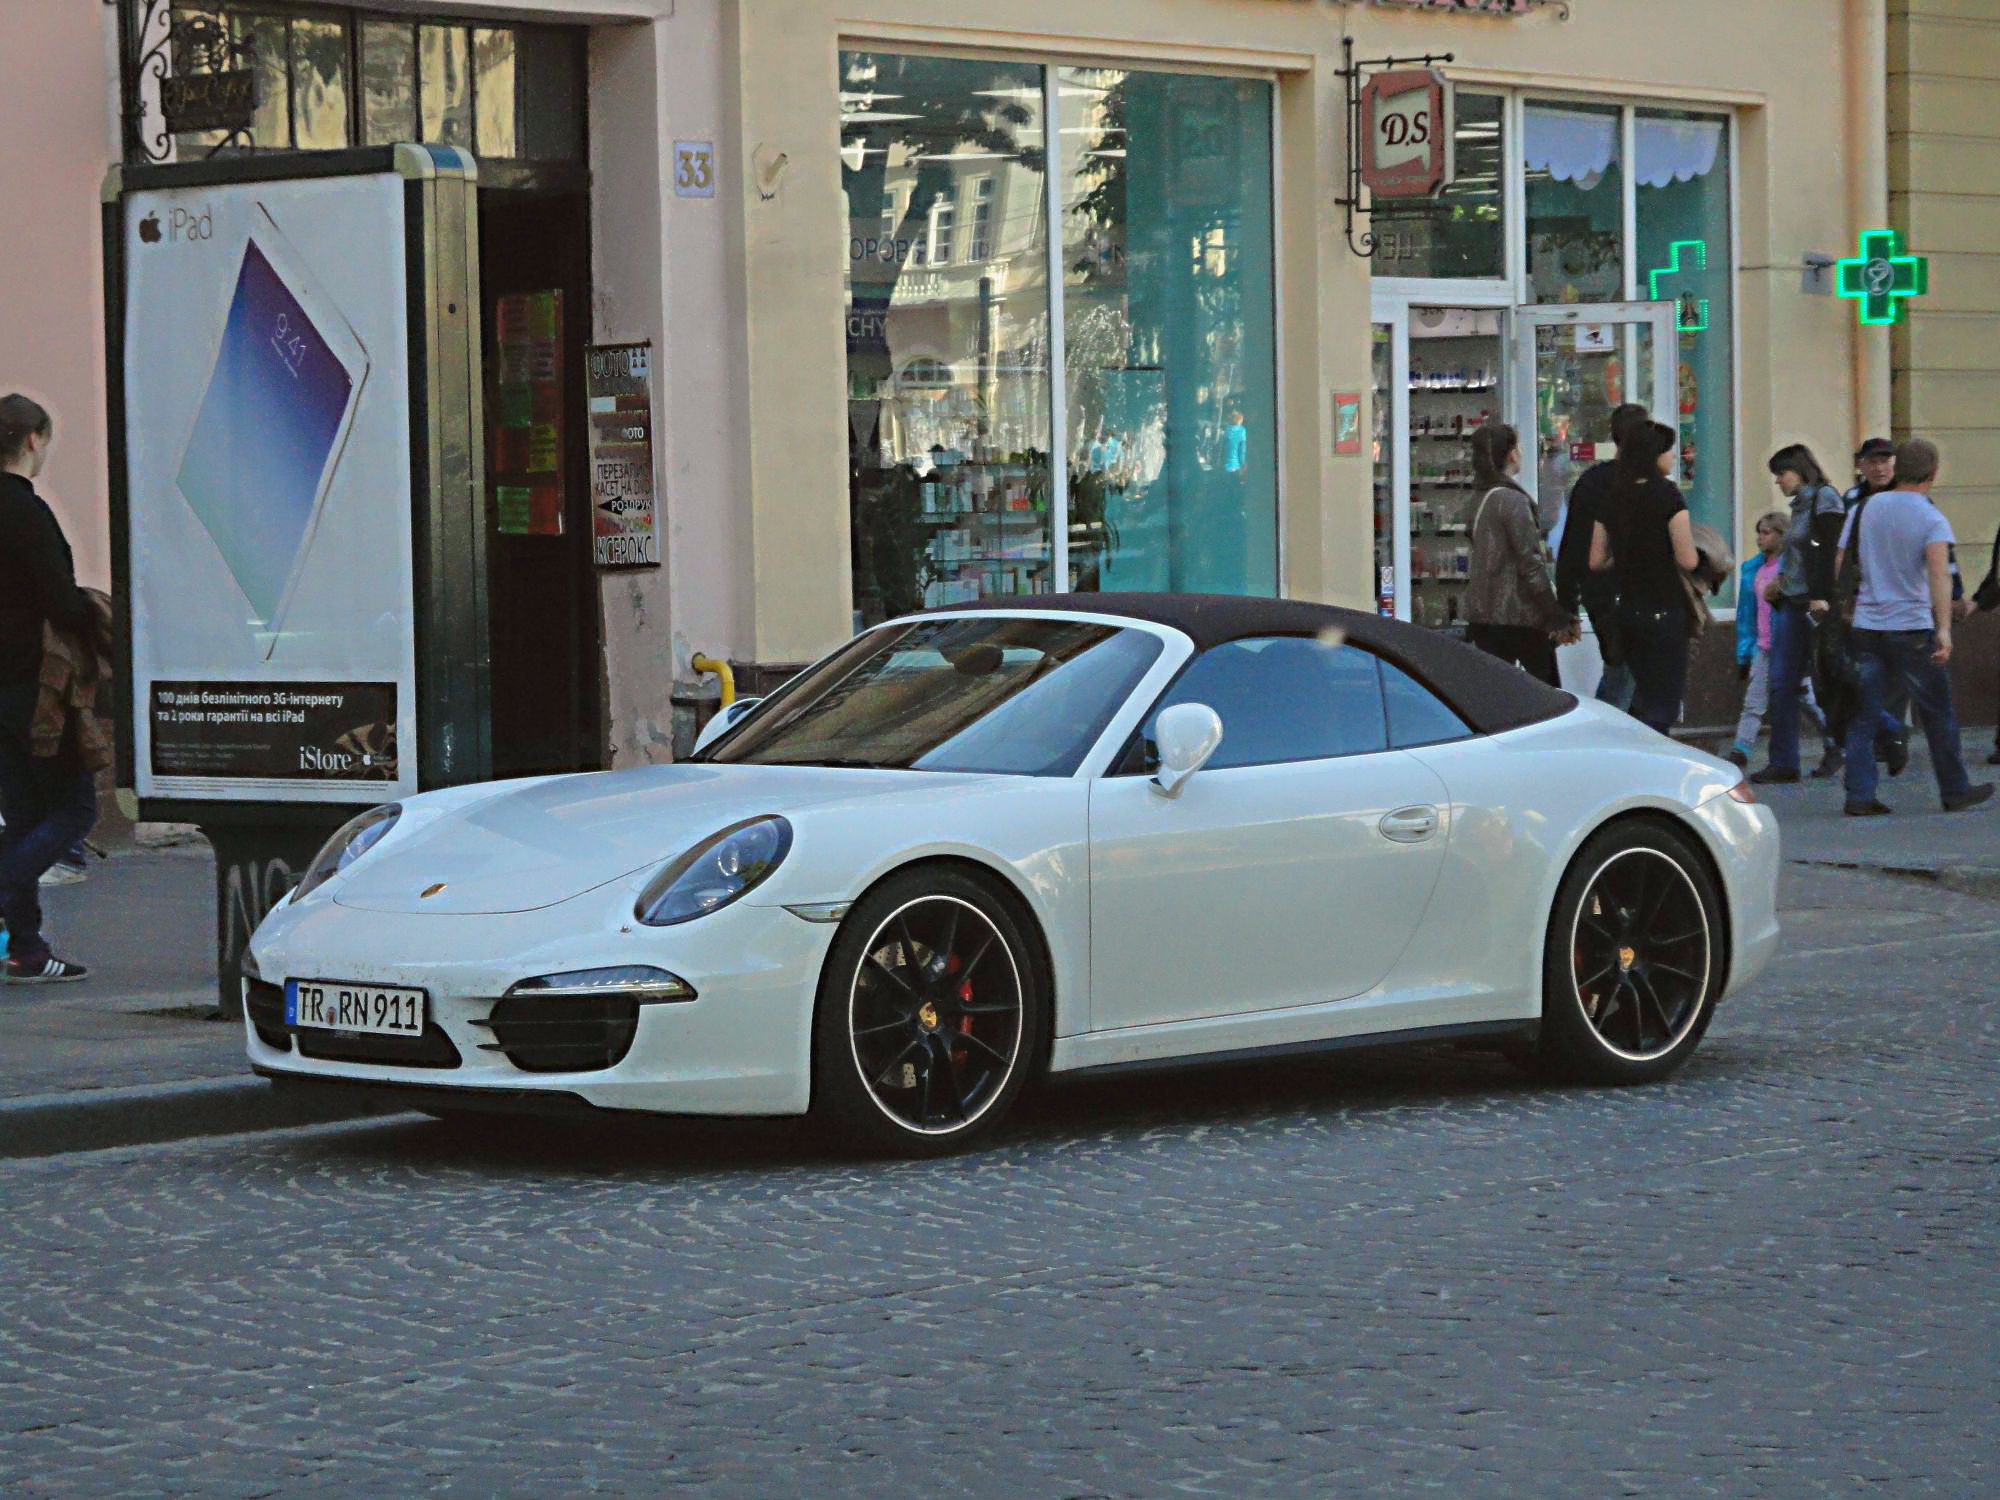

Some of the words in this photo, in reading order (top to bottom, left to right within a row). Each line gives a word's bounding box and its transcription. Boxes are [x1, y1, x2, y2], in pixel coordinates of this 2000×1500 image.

[1381, 111, 1431, 146] D.S.
[679, 151, 712, 188] 33
[169, 205, 214, 241] iPad
[590, 350, 630, 380] ФОТО
[611, 499, 653, 513] РОЗДРУК
[597, 535, 652, 564] КСЕРОКС
[158, 691, 175, 704] 100
[176, 691, 200, 706] днів
[202, 691, 271, 705] безлімітного
[273, 692, 344, 708] 3G-інтернету
[157, 711, 170, 722] та
[171, 709, 177, 721] 2
[179, 711, 204, 724] роки
[207, 709, 249, 725] гарантії
[250, 713, 263, 723] на
[266, 710, 281, 723] всі
[283, 709, 305, 723] iPad
[300, 746, 351, 770] iStore
[299, 987, 324, 1022] TR
[339, 991, 368, 1025] RN
[374, 994, 418, 1030] 911
